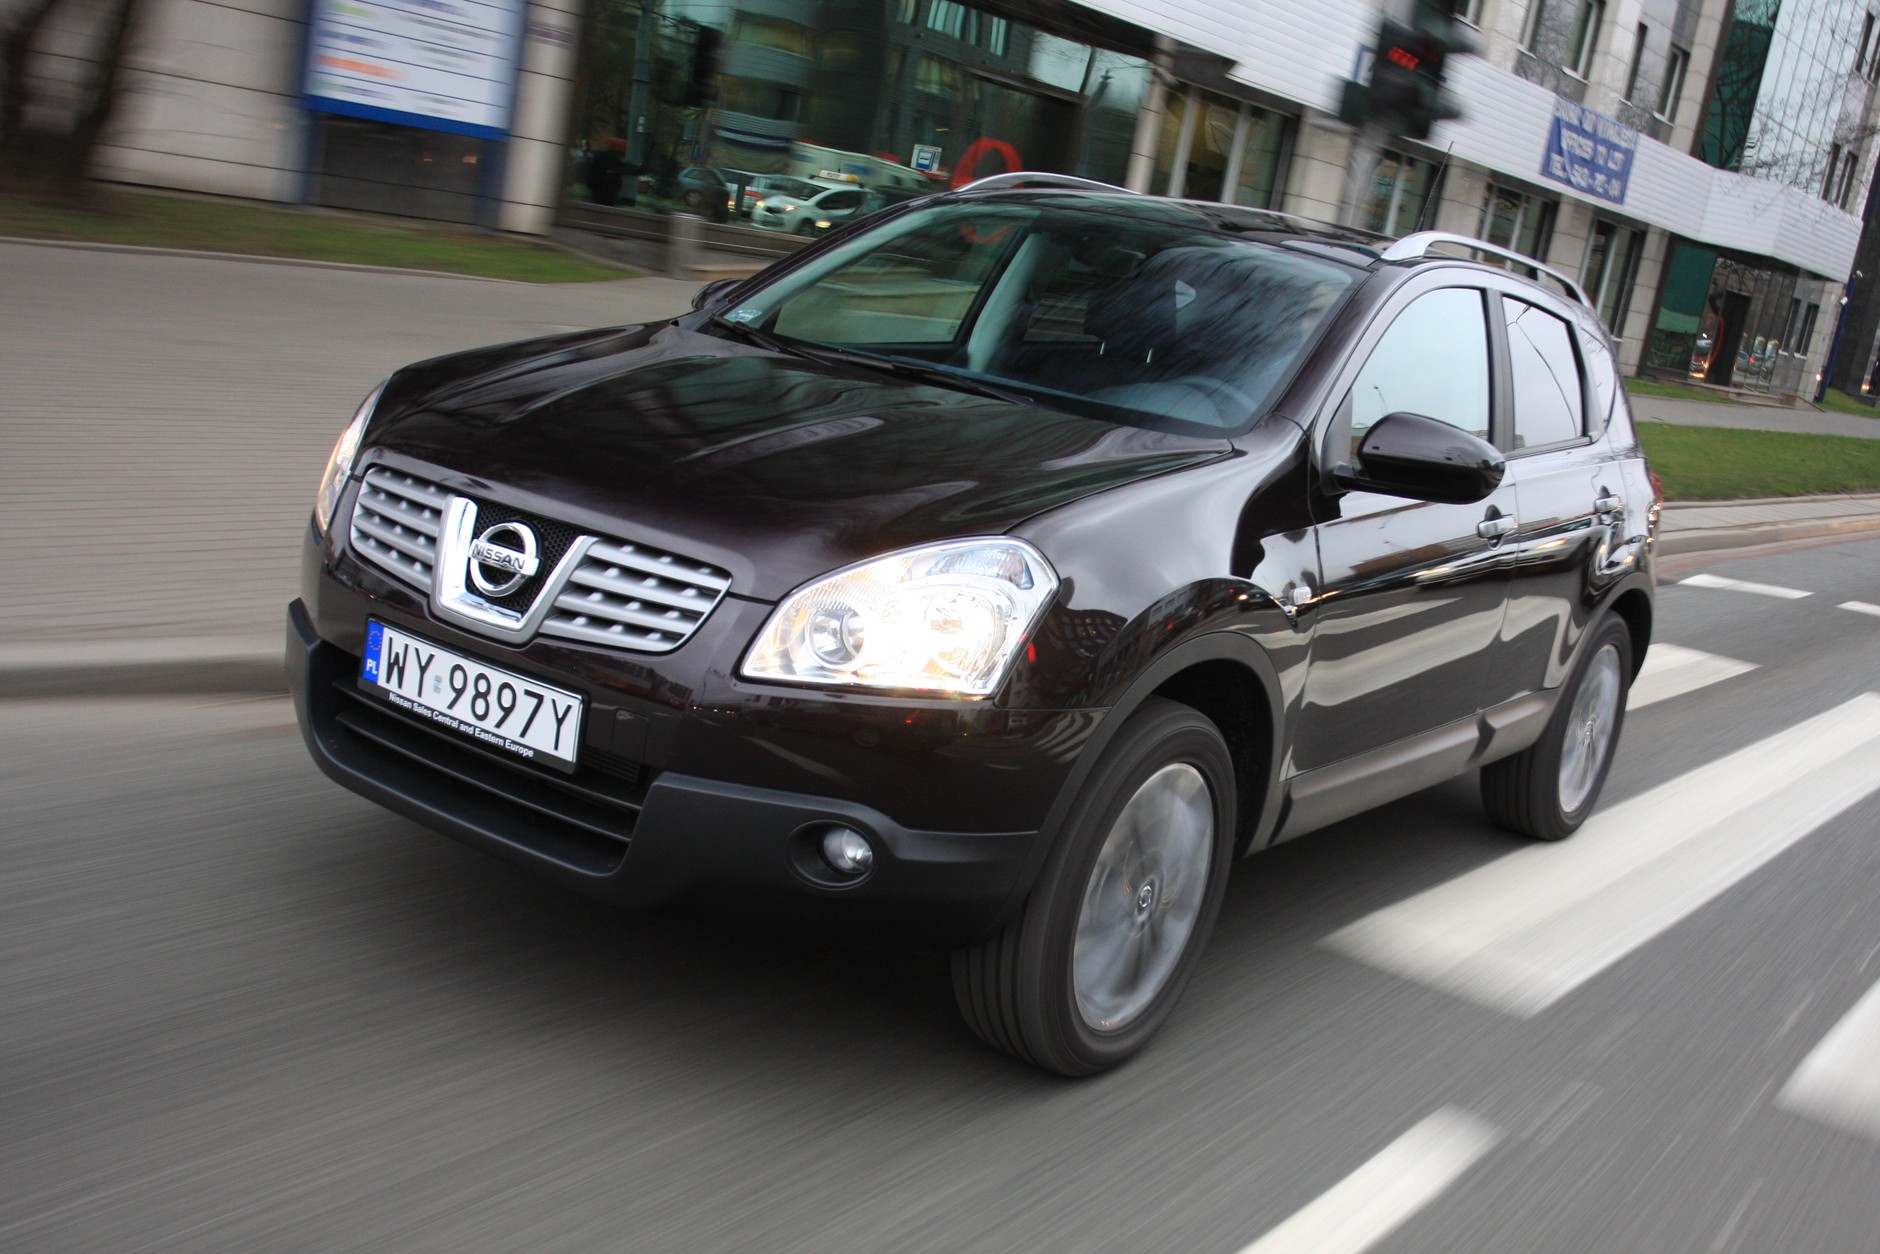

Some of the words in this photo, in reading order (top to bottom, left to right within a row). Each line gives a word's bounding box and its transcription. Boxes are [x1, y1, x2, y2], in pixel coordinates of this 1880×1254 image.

[473, 543, 526, 570] NISSAN
[366, 659, 378, 674] PL
[385, 636, 435, 698] WY
[446, 663, 573, 751] 9897Y
[389, 692, 413, 709] Nissan
[412, 703, 432, 718] Sales
[433, 710, 459, 729] Central
[459, 720, 474, 735] and
[474, 727, 504, 748] Eastern
[505, 739, 534, 759] Europe
